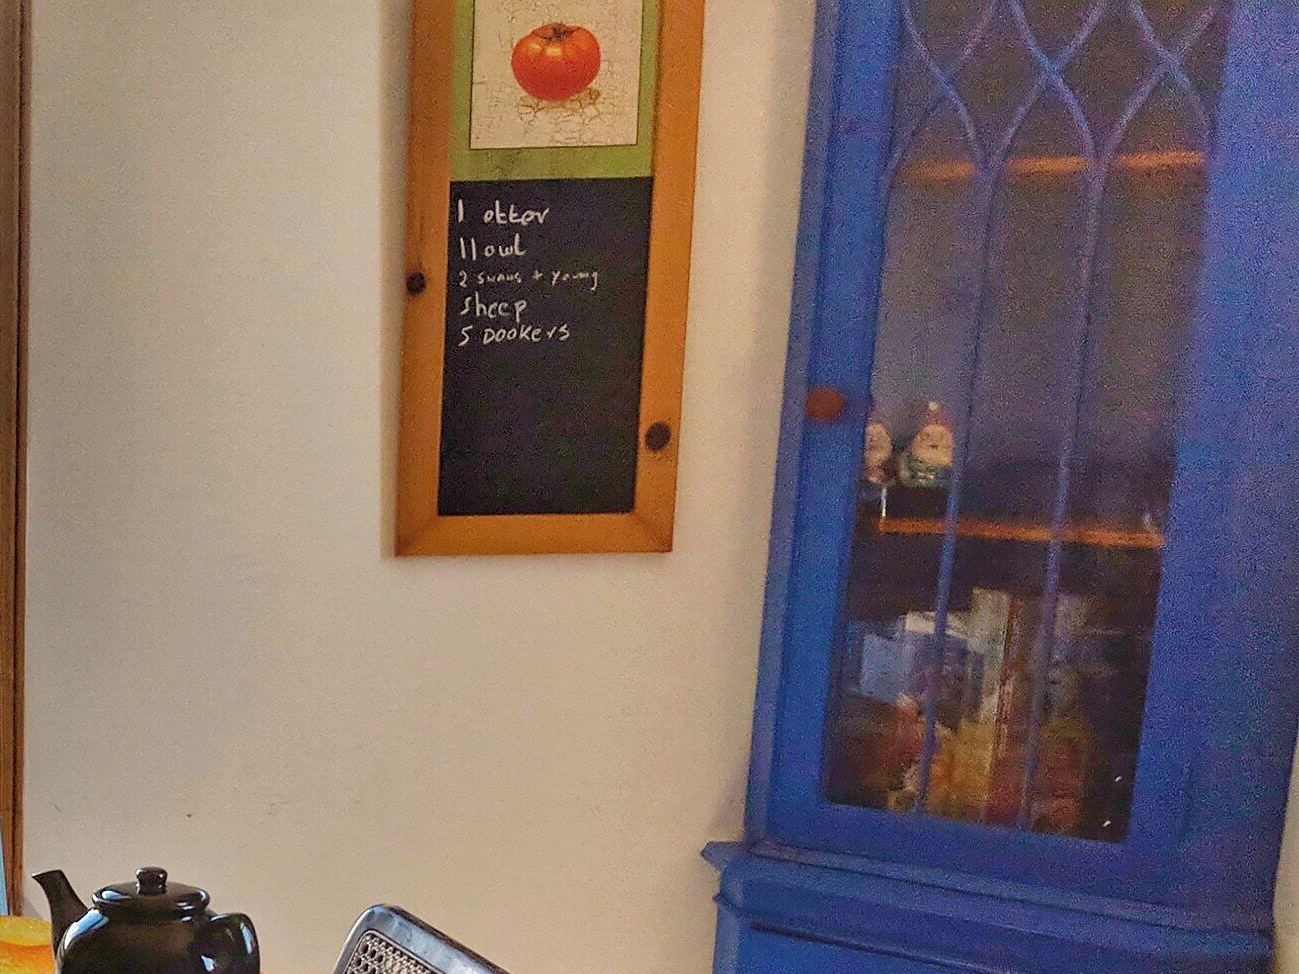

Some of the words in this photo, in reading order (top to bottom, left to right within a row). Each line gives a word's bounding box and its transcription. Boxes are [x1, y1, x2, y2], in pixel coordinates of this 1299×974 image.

[483, 199, 550, 226] otter
[484, 232, 527, 258] owl
[459, 270, 468, 288] 2
[551, 270, 599, 292] young
[458, 325, 473, 347] 5
